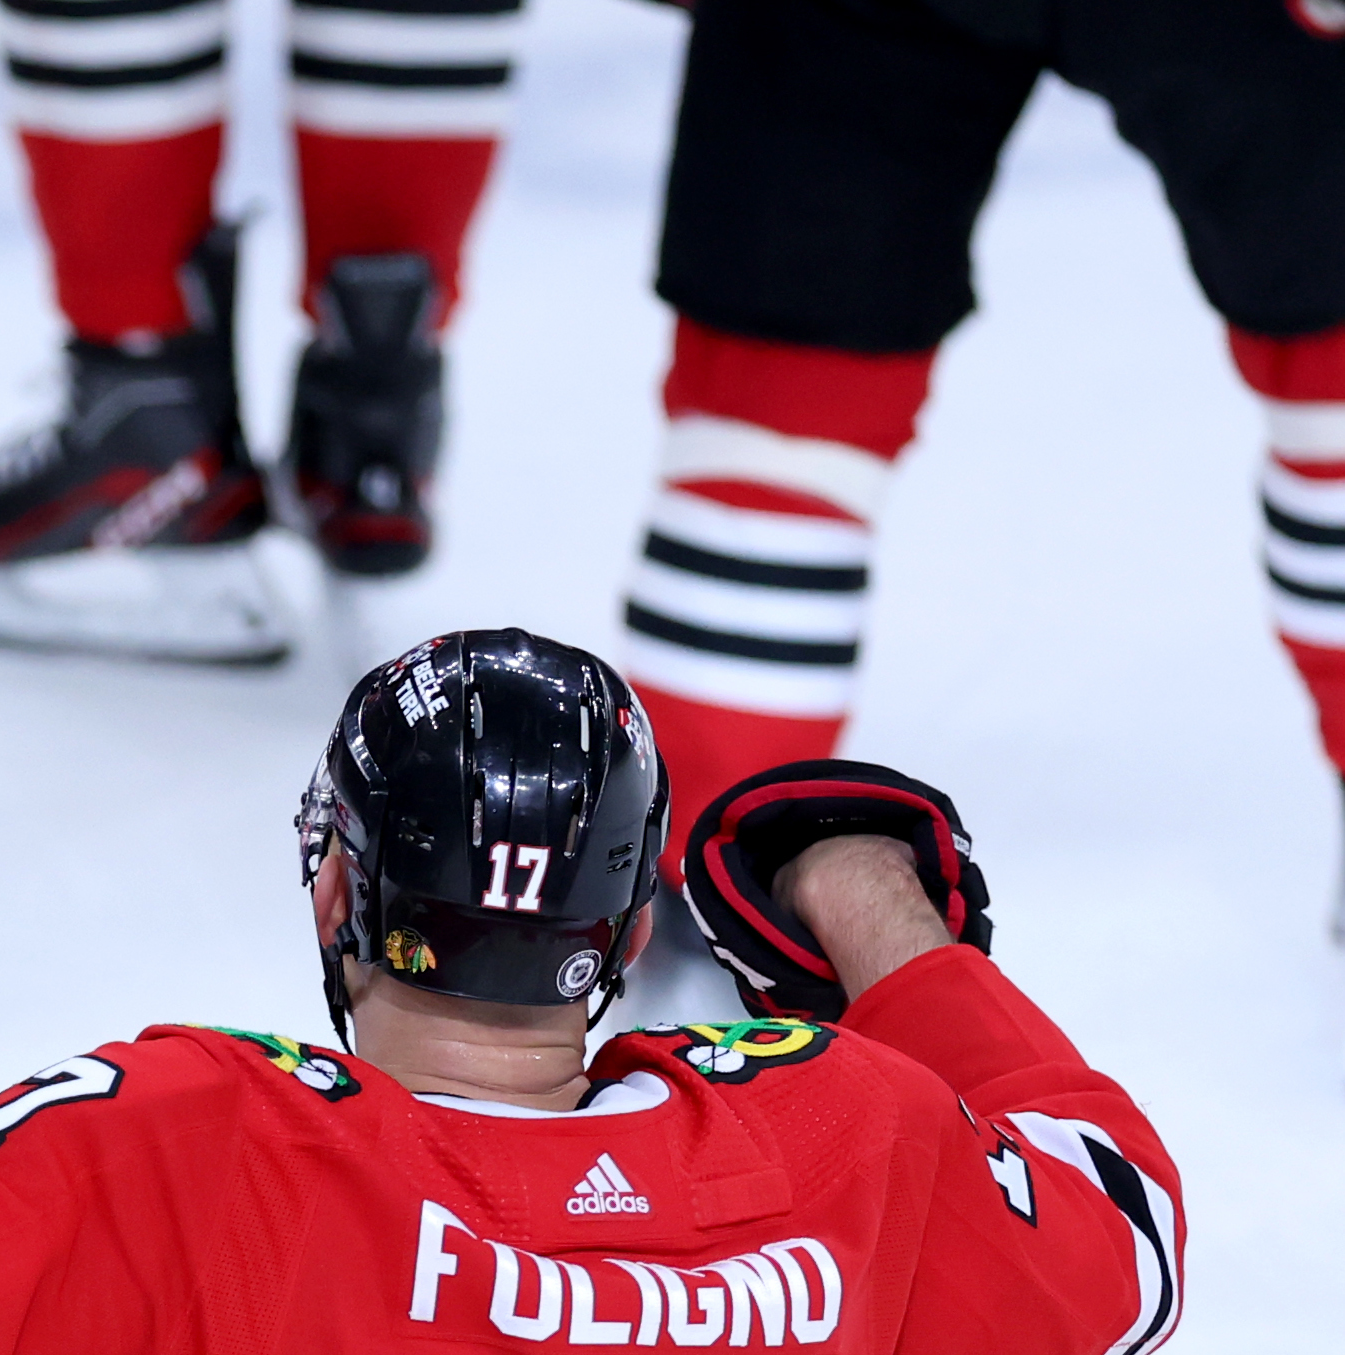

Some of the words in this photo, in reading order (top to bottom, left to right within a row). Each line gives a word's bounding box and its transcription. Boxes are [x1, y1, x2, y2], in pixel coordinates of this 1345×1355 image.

[395, 678, 426, 728] TIRE
[412, 660, 450, 718] BELLE
[481, 841, 551, 913] 17
[566, 1191, 650, 1215] adidas
[409, 1199, 843, 1347] FOLIGNO
